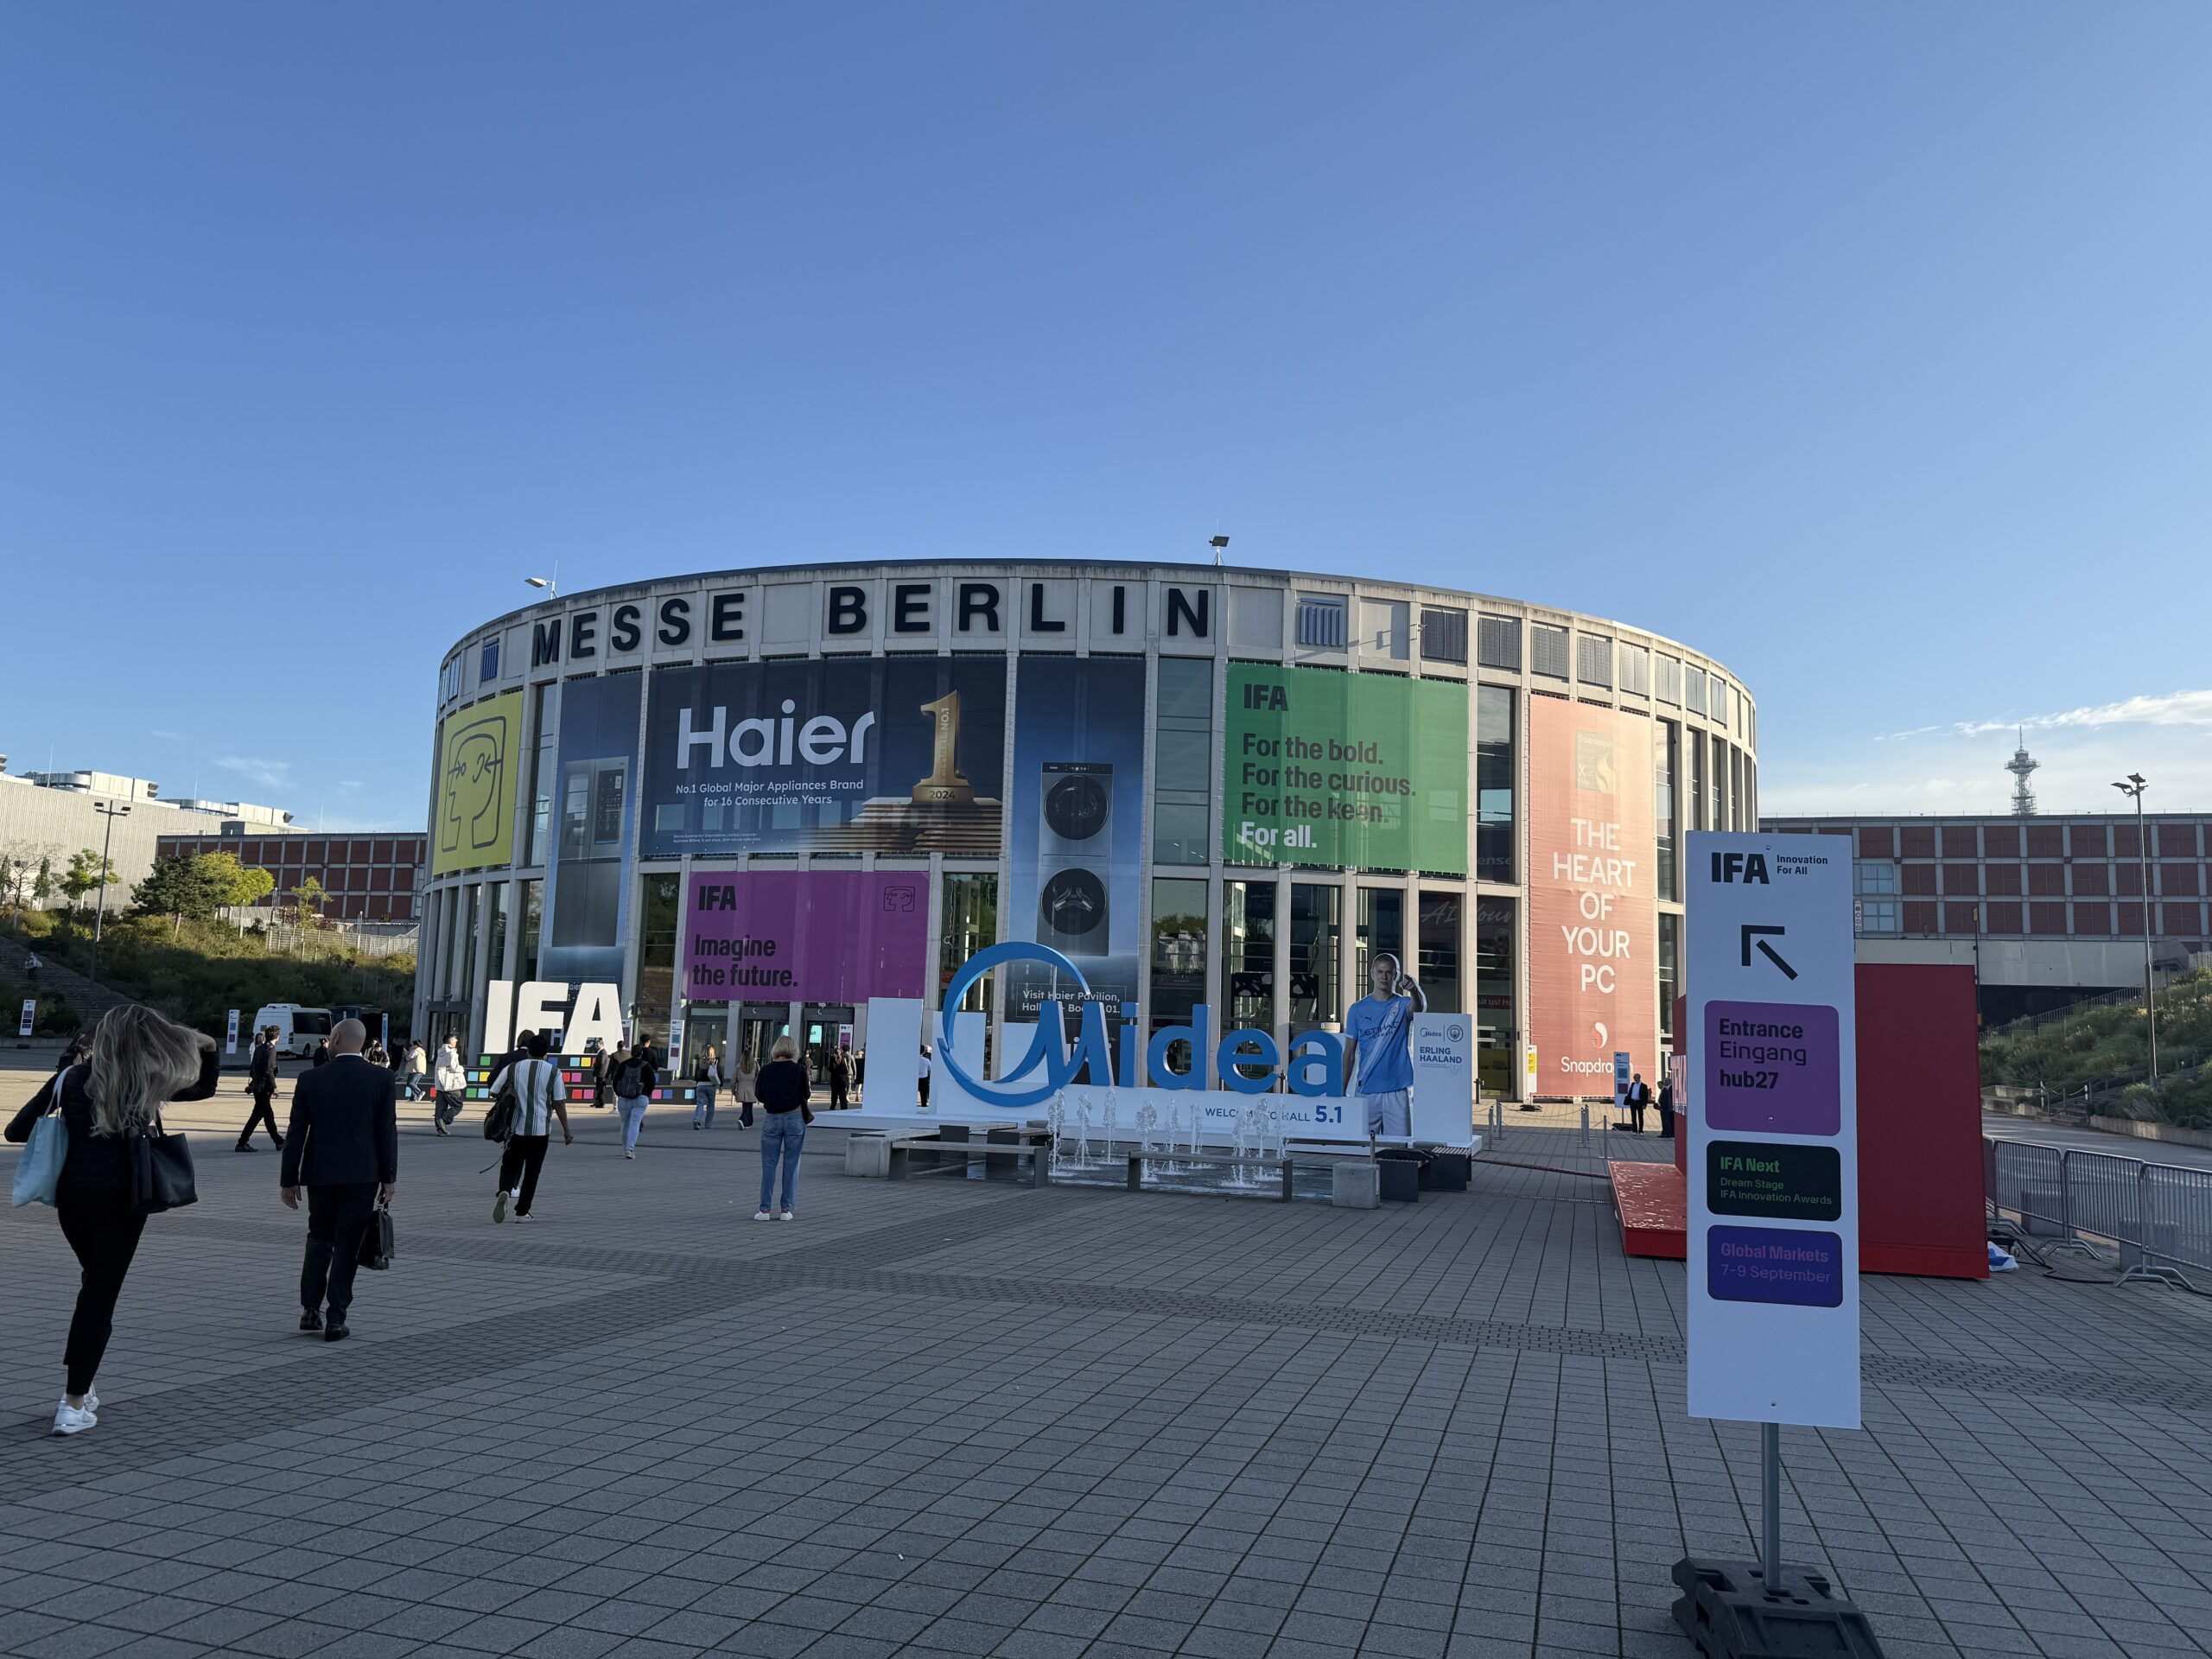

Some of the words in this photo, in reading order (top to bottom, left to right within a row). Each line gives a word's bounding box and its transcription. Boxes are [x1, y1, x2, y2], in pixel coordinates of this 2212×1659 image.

[532, 593, 745, 667] MESSE
[828, 583, 1209, 638] BERLIN
[1243, 683, 1288, 711] IFA
[940, 708, 950, 730] NO.1
[676, 699, 875, 770] Haier
[1243, 734, 1280, 757] For
[1286, 737, 1323, 760] the
[1329, 739, 1383, 764] bold.
[676, 784, 696, 794] No.1
[700, 783, 732, 793] Global
[734, 781, 764, 794] Major
[767, 780, 827, 793] Appliances
[830, 779, 863, 790] Brand
[1243, 763, 1280, 786] For
[1285, 766, 1323, 790] the
[1328, 771, 1416, 796] curious.
[704, 797, 718, 807] for
[721, 797, 732, 806] 16
[735, 794, 798, 806] Consecutive
[801, 795, 832, 804] Years
[929, 790, 956, 800] 2024
[1242, 792, 1280, 815] For
[1284, 796, 1322, 819] the
[1328, 798, 1389, 823] keen.
[1242, 822, 1279, 845] For
[1284, 824, 1317, 849] all.
[1570, 817, 1621, 851] THE
[1554, 852, 1636, 887] HEART
[1712, 852, 1770, 884] IFA
[1777, 855, 1828, 865] Innovation
[1777, 866, 1793, 874] For
[1795, 866, 1808, 875] All
[698, 885, 737, 911] IFA
[1580, 890, 1615, 921] OF
[695, 933, 777, 962] Imagine
[1560, 925, 1630, 959] YOUR
[693, 963, 725, 987] the
[730, 963, 798, 988] future.
[1580, 963, 1616, 994] PC
[1023, 990, 1046, 999] Visit
[1047, 991, 1075, 1001] Haier
[1078, 992, 1120, 1002] Pavilion,
[484, 980, 625, 1054] IFA
[1719, 1018, 1804, 1039] Entrance
[1421, 1027, 1442, 1038] Midea
[1420, 1054, 1462, 1064] HAALAND
[1720, 1040, 1807, 1065] Eingang
[1719, 1069, 1779, 1089] hub27
[1314, 1105, 1342, 1123] 5.1
[1720, 1156, 1744, 1171] IFA
[1746, 1158, 1780, 1173] Next
[1720, 1178, 1753, 1188] Dream
[1755, 1179, 1784, 1191] Stage
[1720, 1190, 1737, 1199] IFA
[1738, 1191, 1791, 1203] Innovation
[1794, 1194, 1833, 1205] Awards
[1720, 1243, 1766, 1259] Global
[1770, 1246, 1829, 1262] Markets
[1720, 1264, 1747, 1278] 7-9
[1750, 1266, 1832, 1283] September
